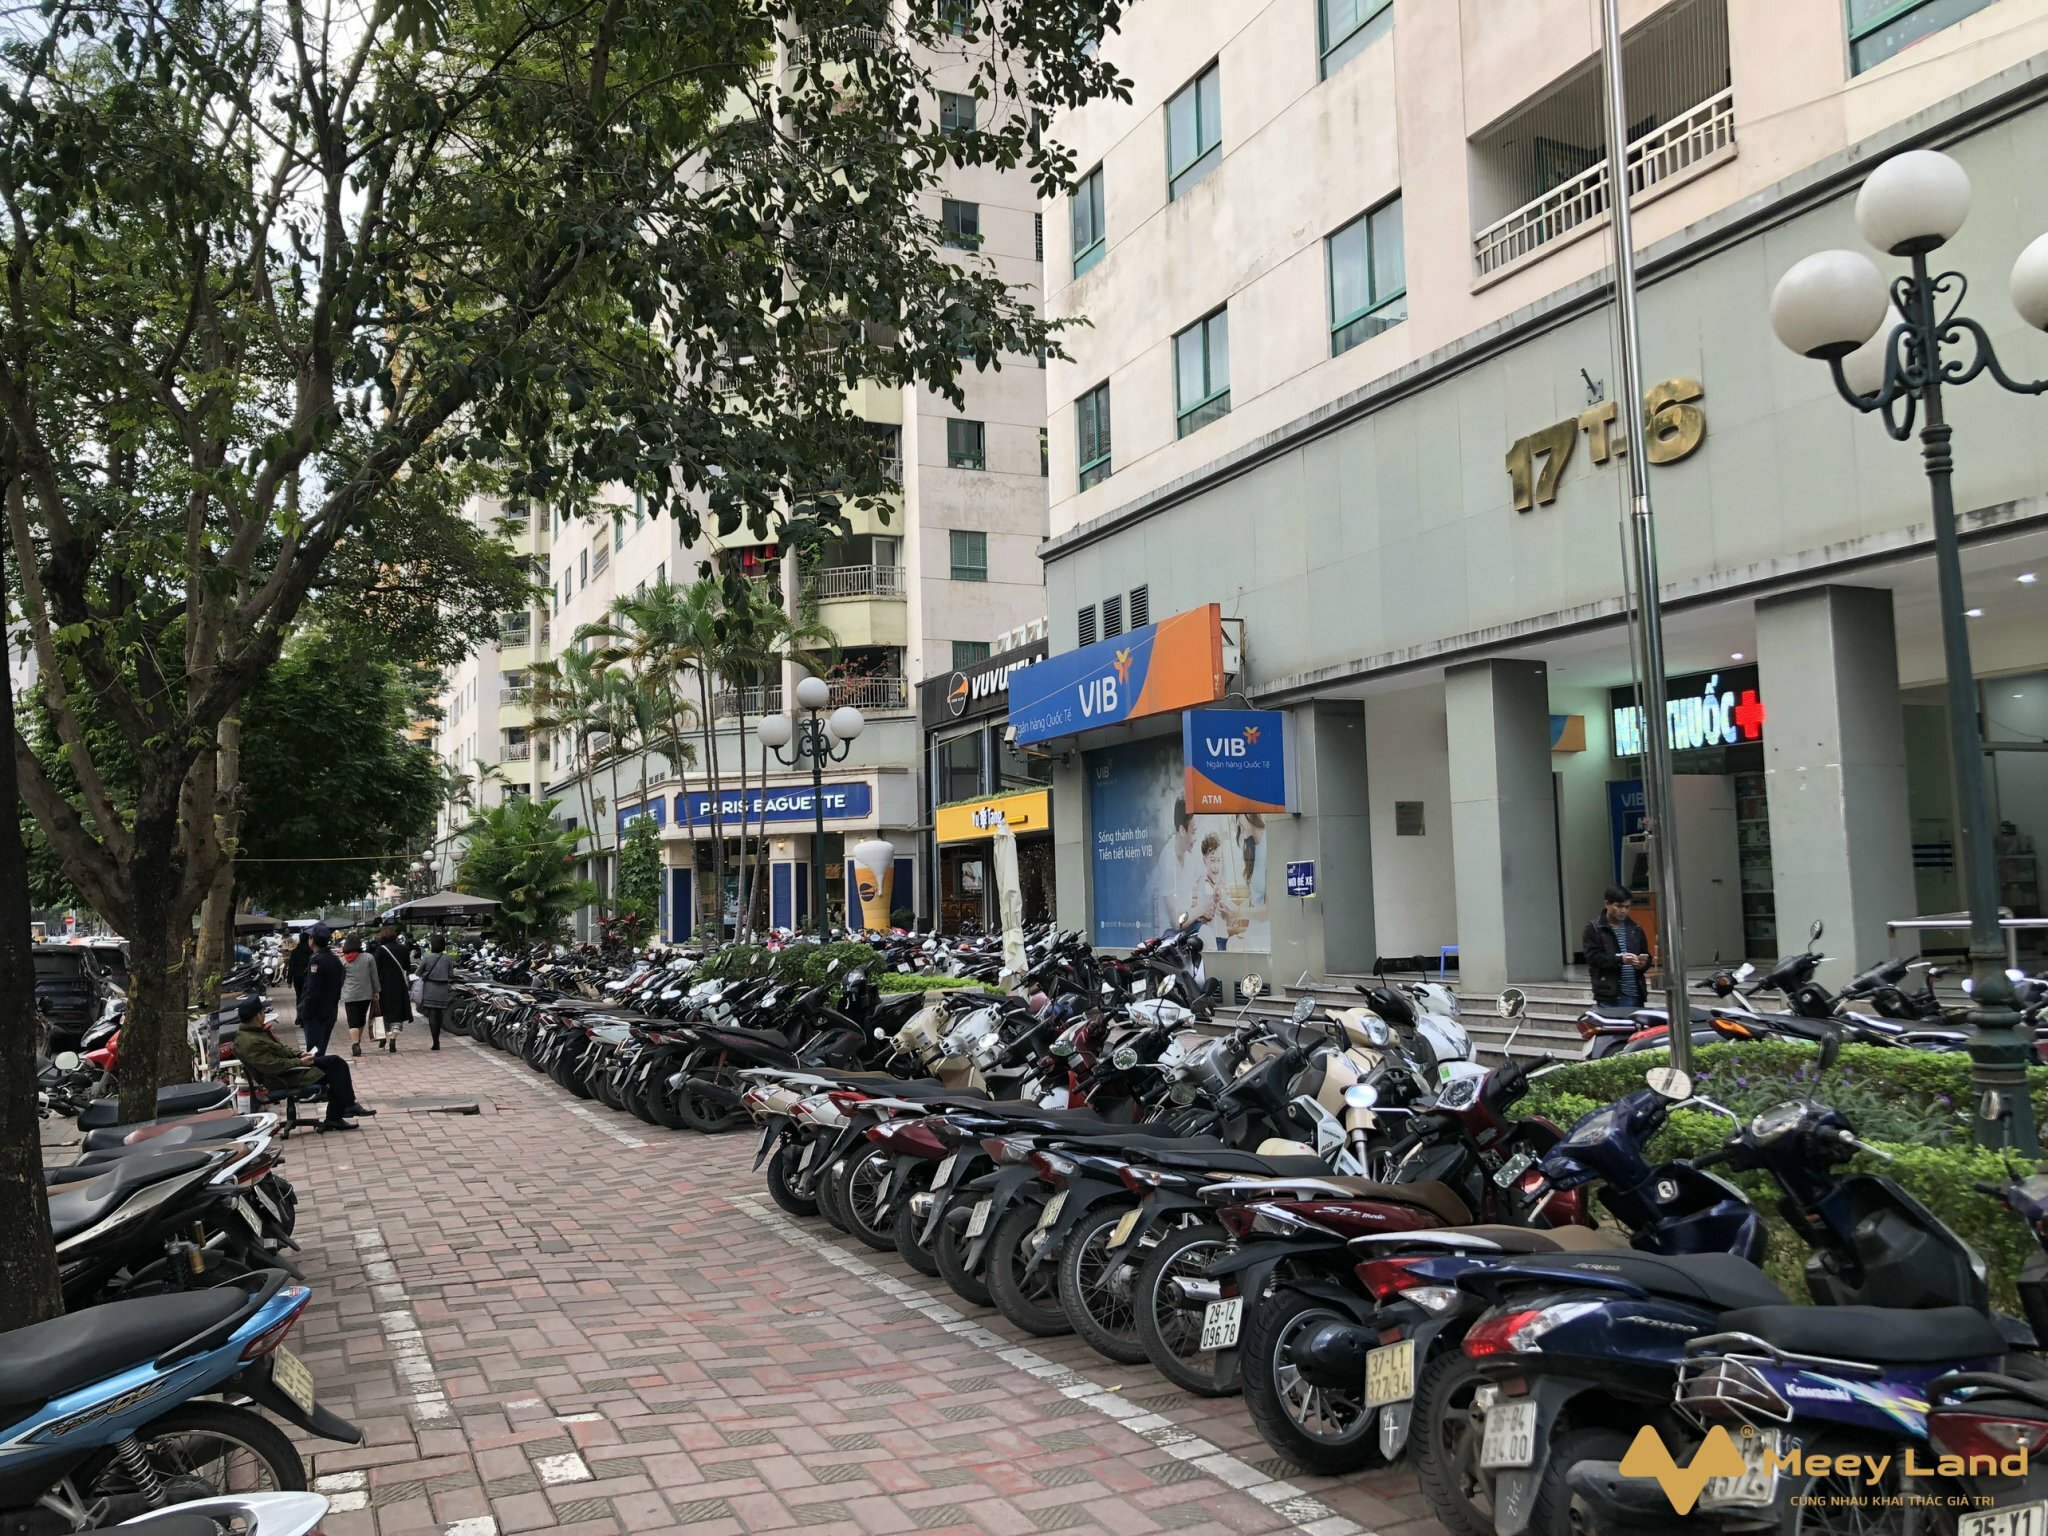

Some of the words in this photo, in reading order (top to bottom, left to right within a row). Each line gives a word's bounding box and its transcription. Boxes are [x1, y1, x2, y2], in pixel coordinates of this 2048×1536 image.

[1078, 675, 1119, 718] VIB
[1666, 674, 1738, 750] THUỐC
[1205, 737, 1246, 757] VIB
[1096, 766, 1110, 779] VIB
[1206, 760, 1225, 770] Ngân
[1225, 760, 1243, 770] hàng
[1243, 760, 1261, 769] Quốc
[1261, 760, 1271, 769] Tế
[1201, 795, 1222, 805] ATM
[1098, 828, 1114, 845] Sống
[1141, 844, 1153, 857] VIB
[1305, 876, 1313, 886] XE
[1209, 1301, 1236, 1325] 29-T2
[1203, 1323, 1236, 1347] 096.78
[1372, 1346, 1404, 1377] 37-L1
